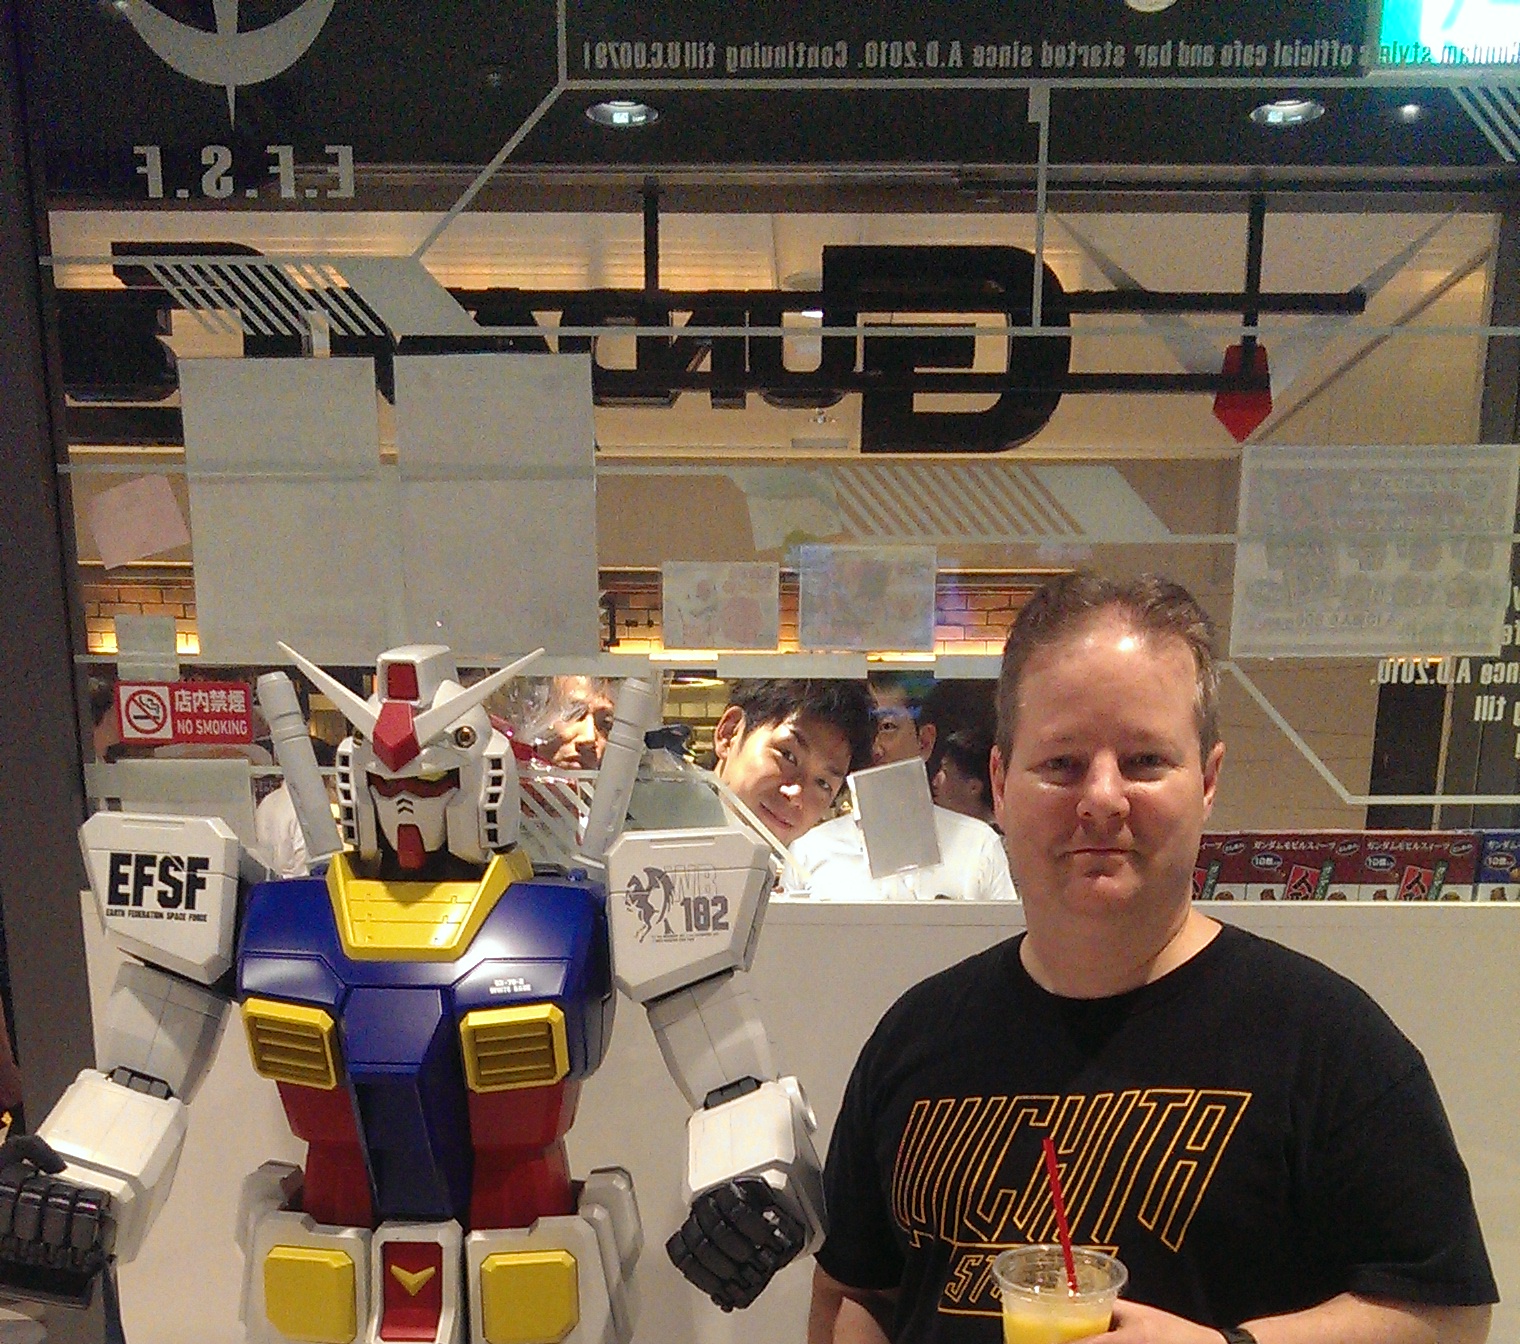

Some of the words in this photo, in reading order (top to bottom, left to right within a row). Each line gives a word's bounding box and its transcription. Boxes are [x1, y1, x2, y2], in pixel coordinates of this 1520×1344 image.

[174, 689, 247, 713] 店内禁煙
[176, 719, 193, 735] NO
[196, 719, 248, 735] SMOKING
[107, 852, 210, 910] EFSF
[892, 1087, 1253, 1253] WICHITA
